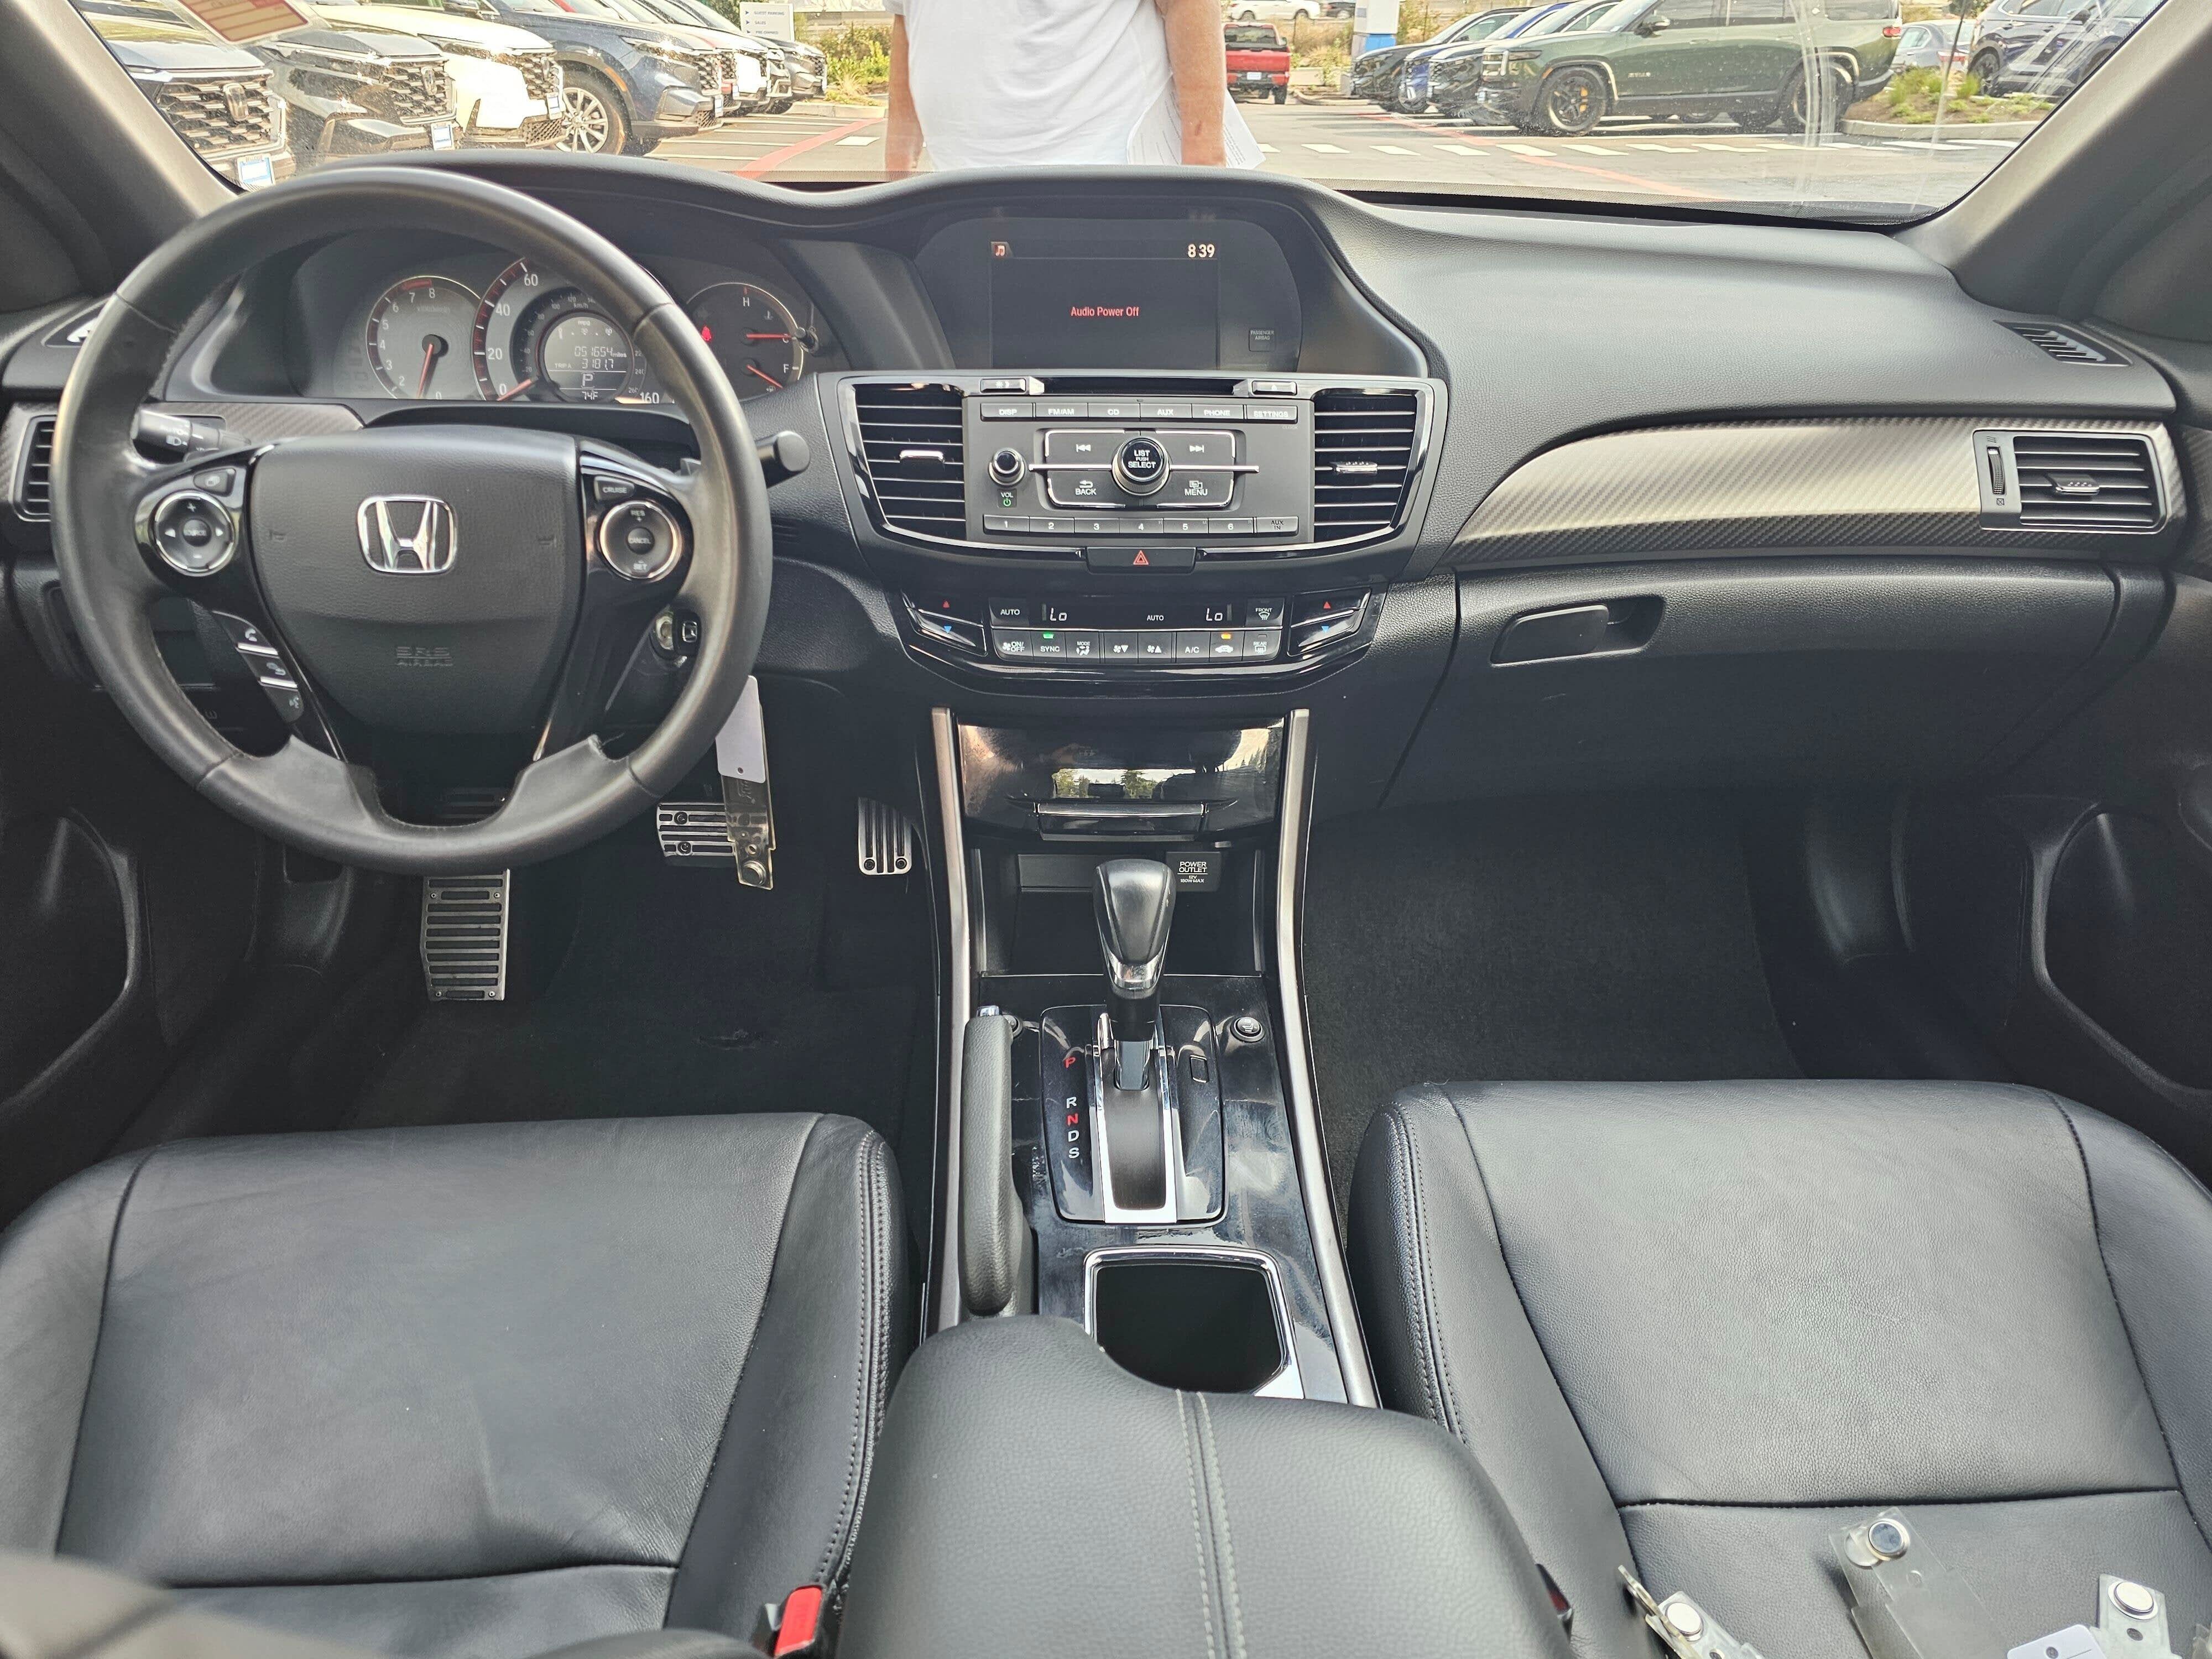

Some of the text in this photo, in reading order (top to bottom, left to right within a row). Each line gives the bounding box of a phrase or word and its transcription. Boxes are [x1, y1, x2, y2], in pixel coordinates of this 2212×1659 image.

[524, 274, 538, 286] 60
[409, 293, 415, 302] 7
[429, 288, 435, 299] 8
[393, 302, 399, 312] 6
[743, 297, 750, 307] H
[495, 303, 510, 316] 40
[1071, 306, 1139, 316] Audio Power Off
[382, 319, 389, 330] 5
[379, 340, 385, 350] 4
[488, 348, 503, 360] 20
[575, 346, 613, 357] 051654
[386, 360, 392, 370] 3
[784, 363, 789, 373] F
[399, 375, 405, 386] 2
[582, 373, 593, 387] P
[499, 384, 507, 395] 0
[639, 392, 659, 404] 160
[1050, 608, 1067, 621] Lo
[1206, 608, 1223, 621] Lo
[1065, 1056, 1076, 1068] P
[1066, 1097, 1077, 1109] R
[1067, 1113, 1078, 1126] N
[1068, 1130, 1079, 1142] D
[1068, 1146, 1080, 1159] S
